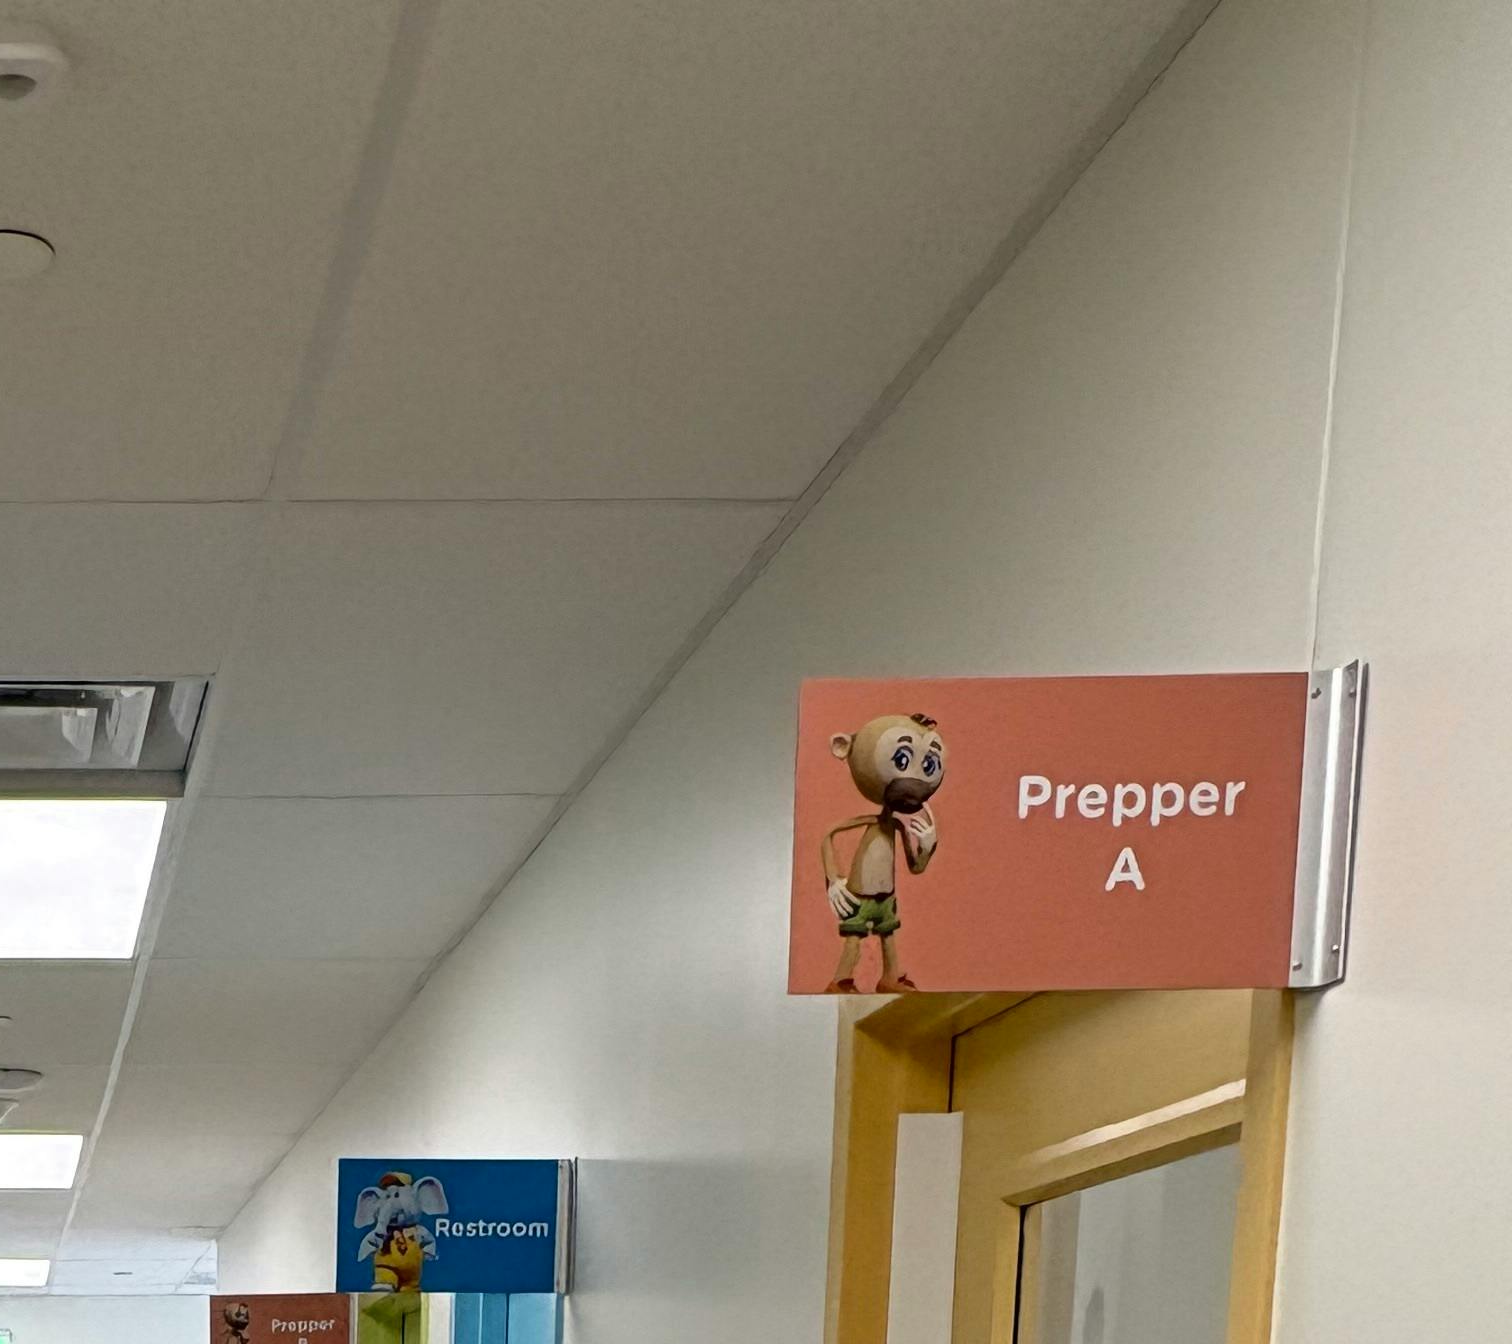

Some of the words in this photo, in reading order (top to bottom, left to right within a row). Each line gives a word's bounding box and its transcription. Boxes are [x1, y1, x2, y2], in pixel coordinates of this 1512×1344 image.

[1018, 775, 1246, 827] Prepper
[1104, 847, 1145, 892] A
[435, 1218, 549, 1238] Restroom
